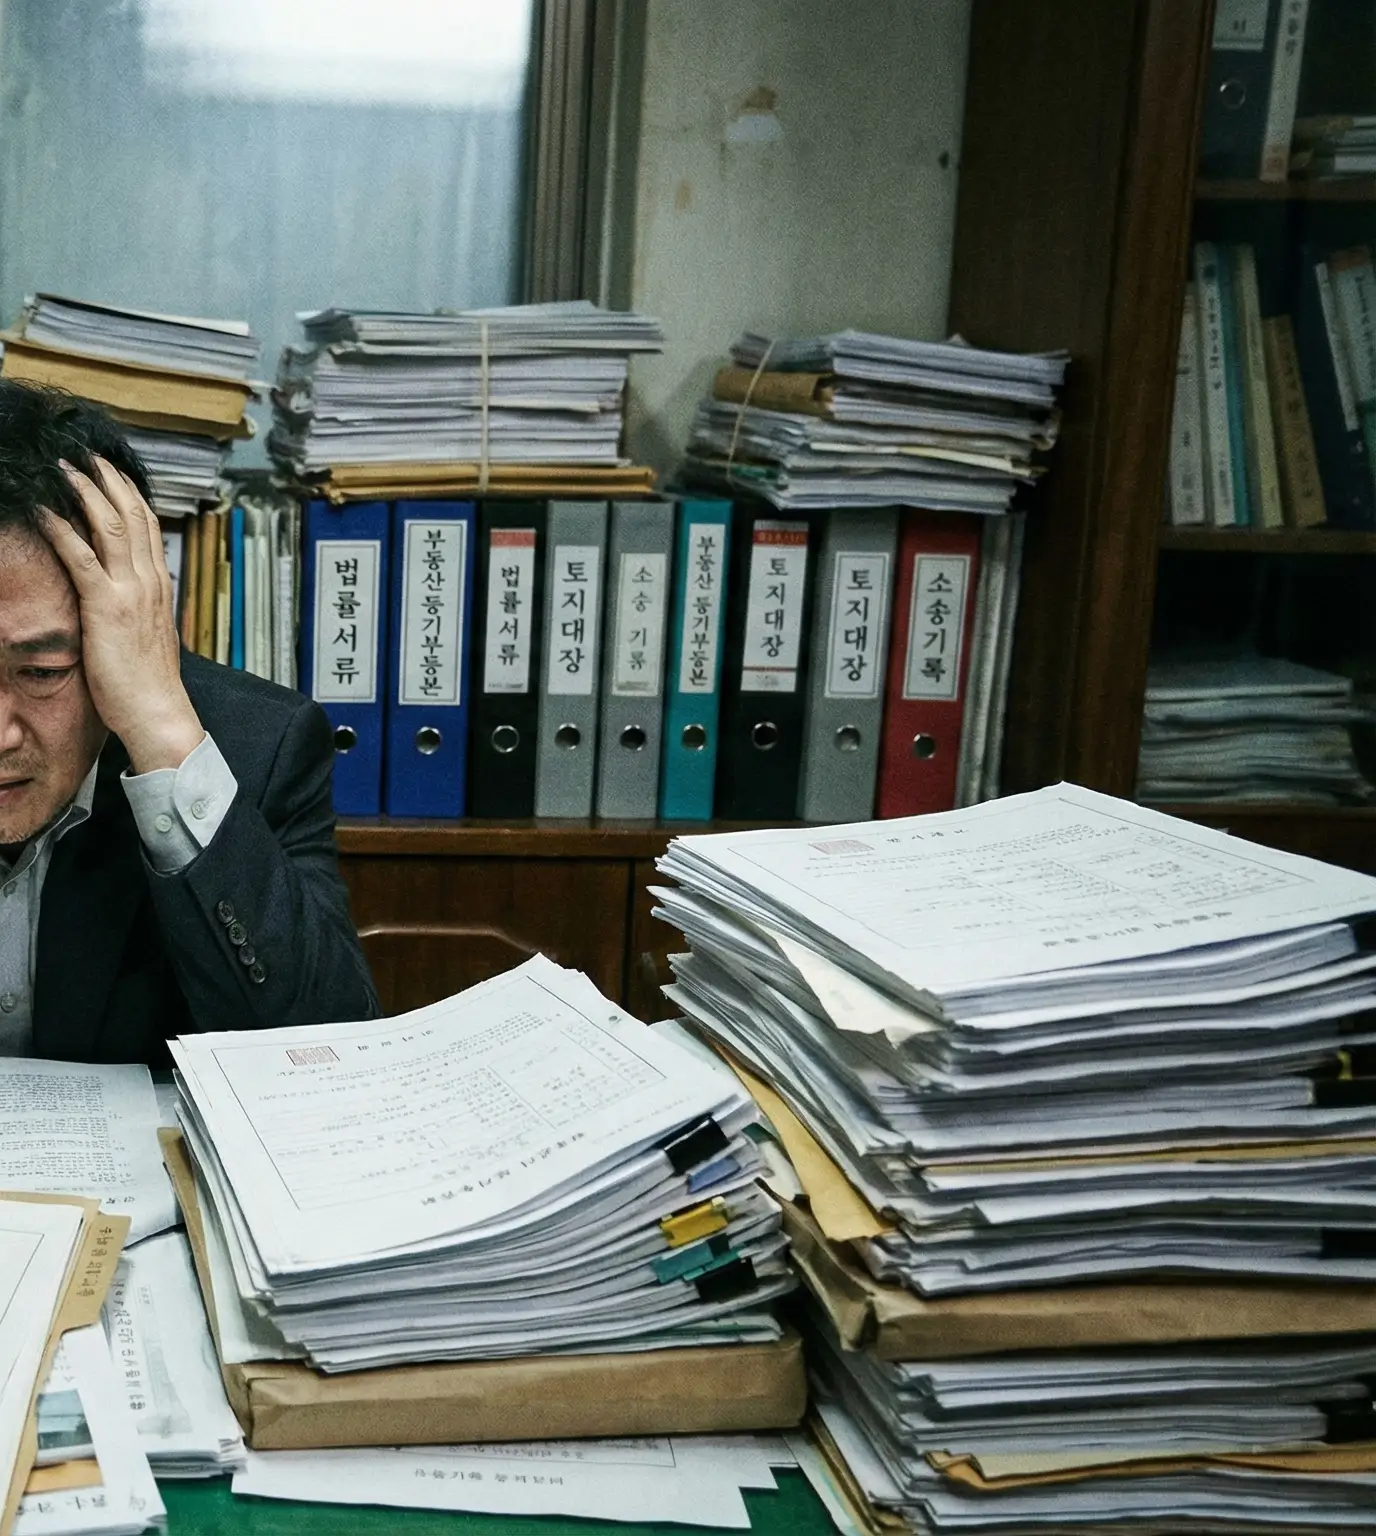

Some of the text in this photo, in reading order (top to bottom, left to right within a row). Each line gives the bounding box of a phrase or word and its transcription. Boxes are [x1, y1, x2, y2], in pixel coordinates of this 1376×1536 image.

[331, 557, 362, 686] 법률서류
[419, 529, 447, 697] 부동산등기부등본
[497, 564, 523, 667] 법률서류
[558, 560, 589, 674] 토지대장
[760, 556, 789, 659] 토지대장
[840, 568, 873, 682] 토지대장
